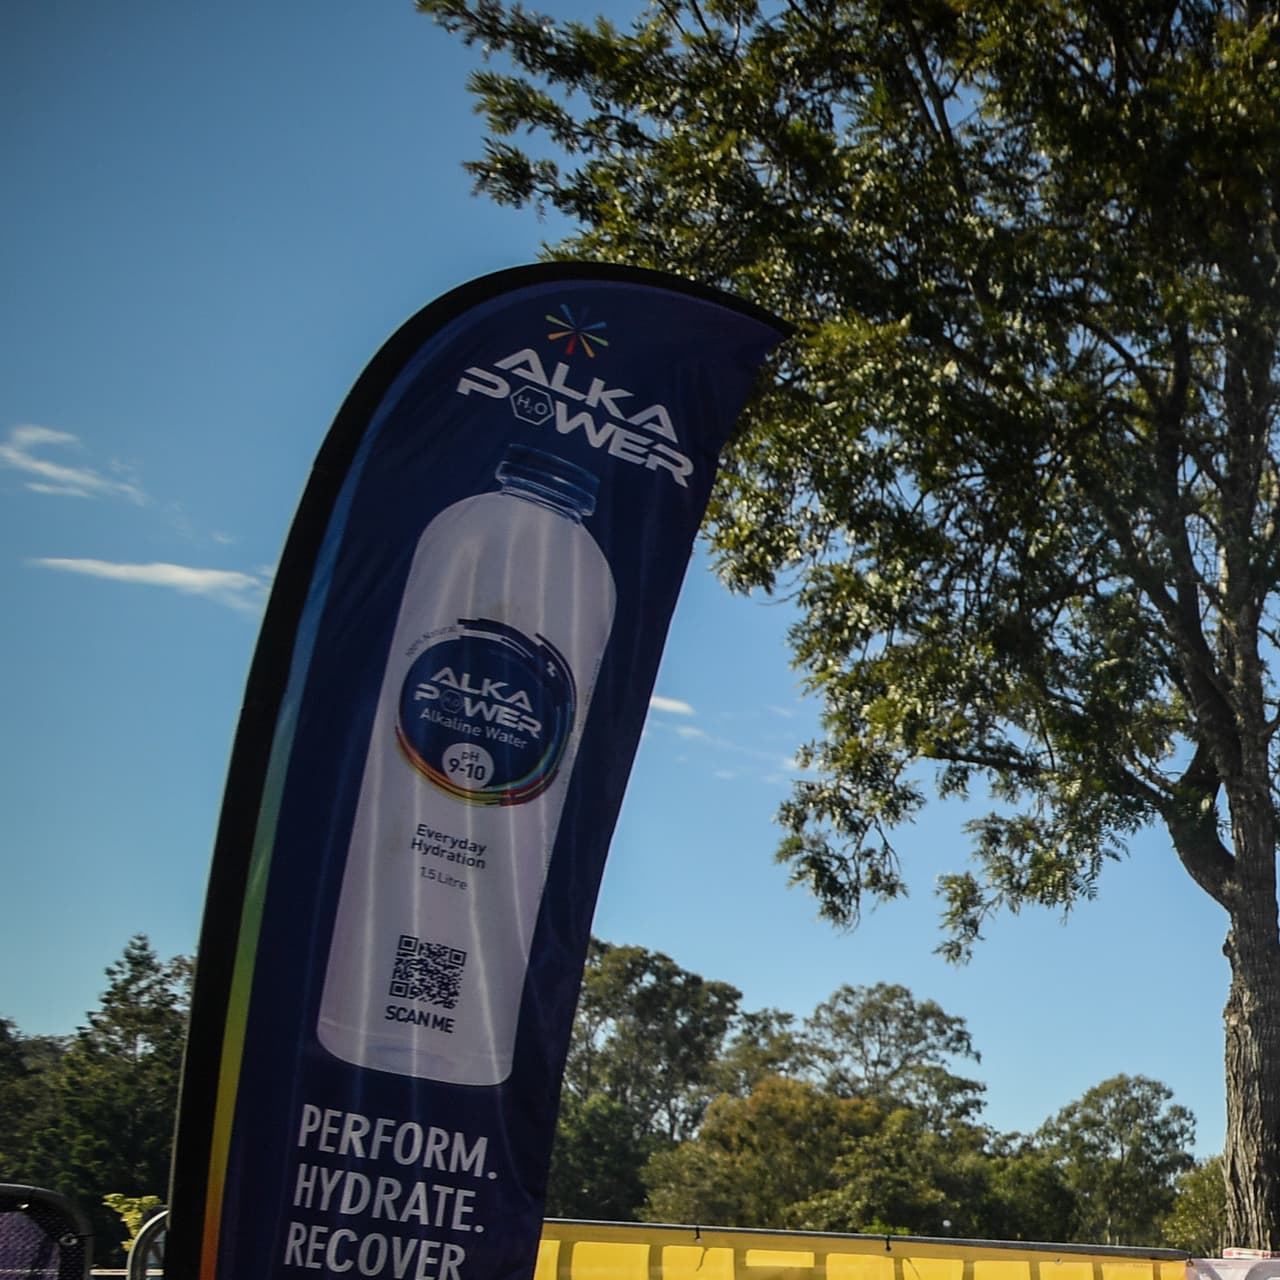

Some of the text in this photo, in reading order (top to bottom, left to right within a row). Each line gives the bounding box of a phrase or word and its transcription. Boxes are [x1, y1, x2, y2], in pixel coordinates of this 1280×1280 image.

[493, 348, 679, 444] ALKA
[431, 667, 533, 712] ALKA
[420, 708, 527, 749] Alkaline Water
[448, 758, 485, 781] 9-10
[461, 751, 479, 763] pH
[411, 838, 486, 869] Hydration
[416, 823, 487, 857] Everyday
[437, 871, 467, 890] Litre
[384, 1004, 456, 1033] SCAN ME
[298, 1103, 498, 1180] PERFORM.
[293, 1163, 484, 1234] HYDRATE.
